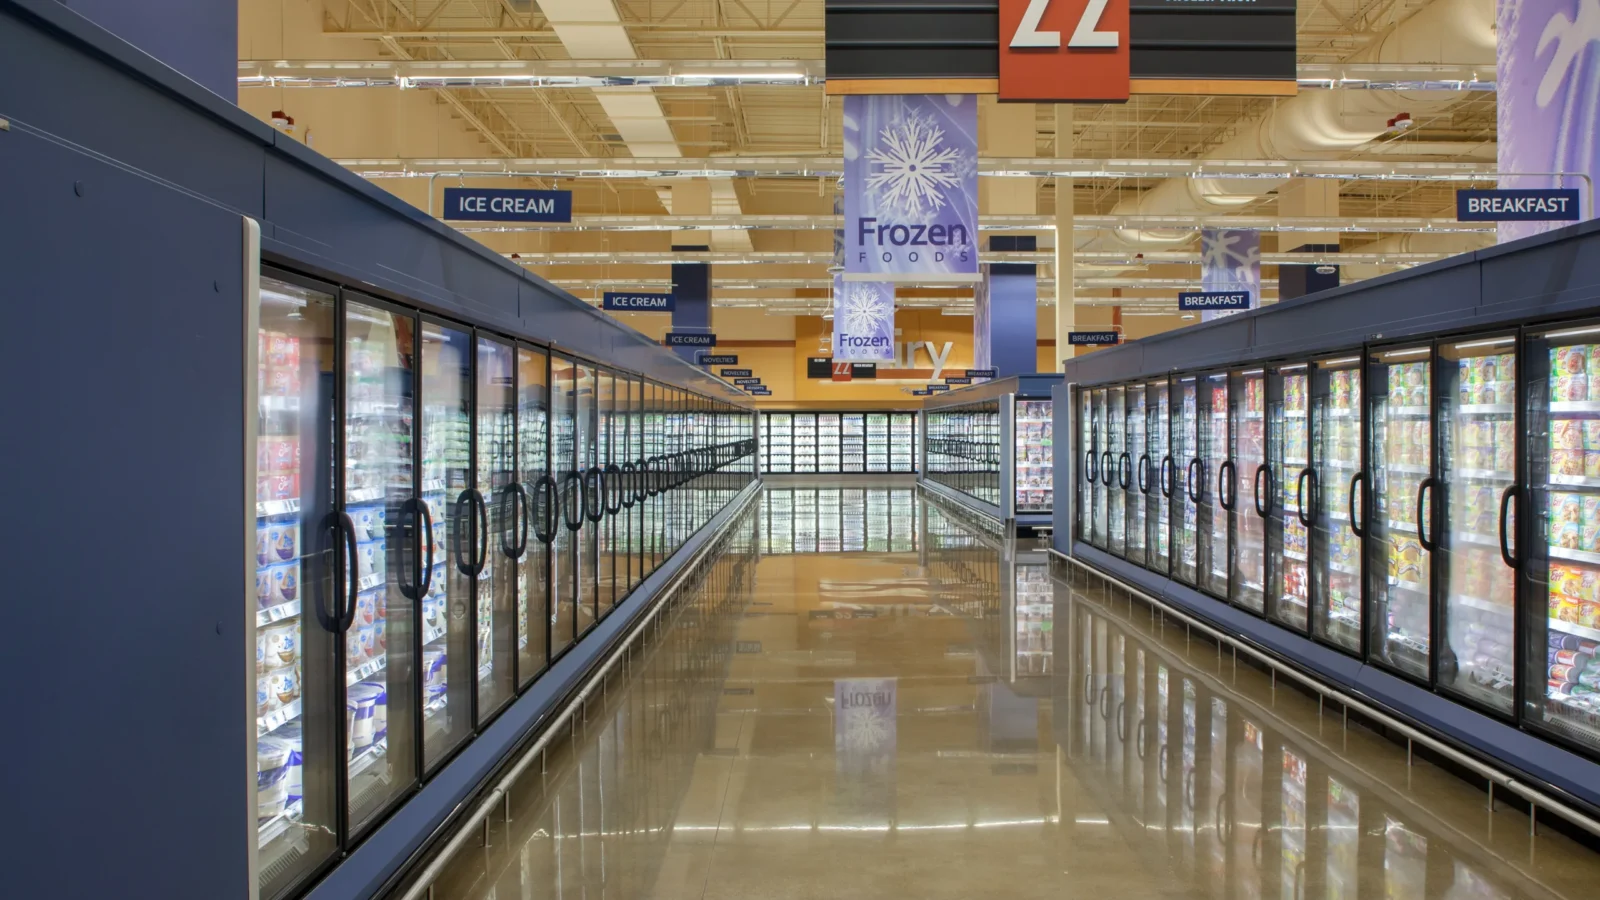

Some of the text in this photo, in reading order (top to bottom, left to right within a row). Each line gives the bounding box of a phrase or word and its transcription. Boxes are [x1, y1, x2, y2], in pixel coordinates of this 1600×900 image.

[459, 197, 554, 214] ICE CREAM
[1468, 198, 1569, 213] BREAKFAST
[858, 217, 967, 246] Frozen
[859, 252, 968, 263] FOODS
[612, 296, 667, 307] ICE CREAM
[1185, 295, 1244, 306] BREAKFAST
[685, 336, 710, 344] CREAM
[839, 333, 889, 347] Frozen
[1072, 334, 1114, 342] BREAKFAST
